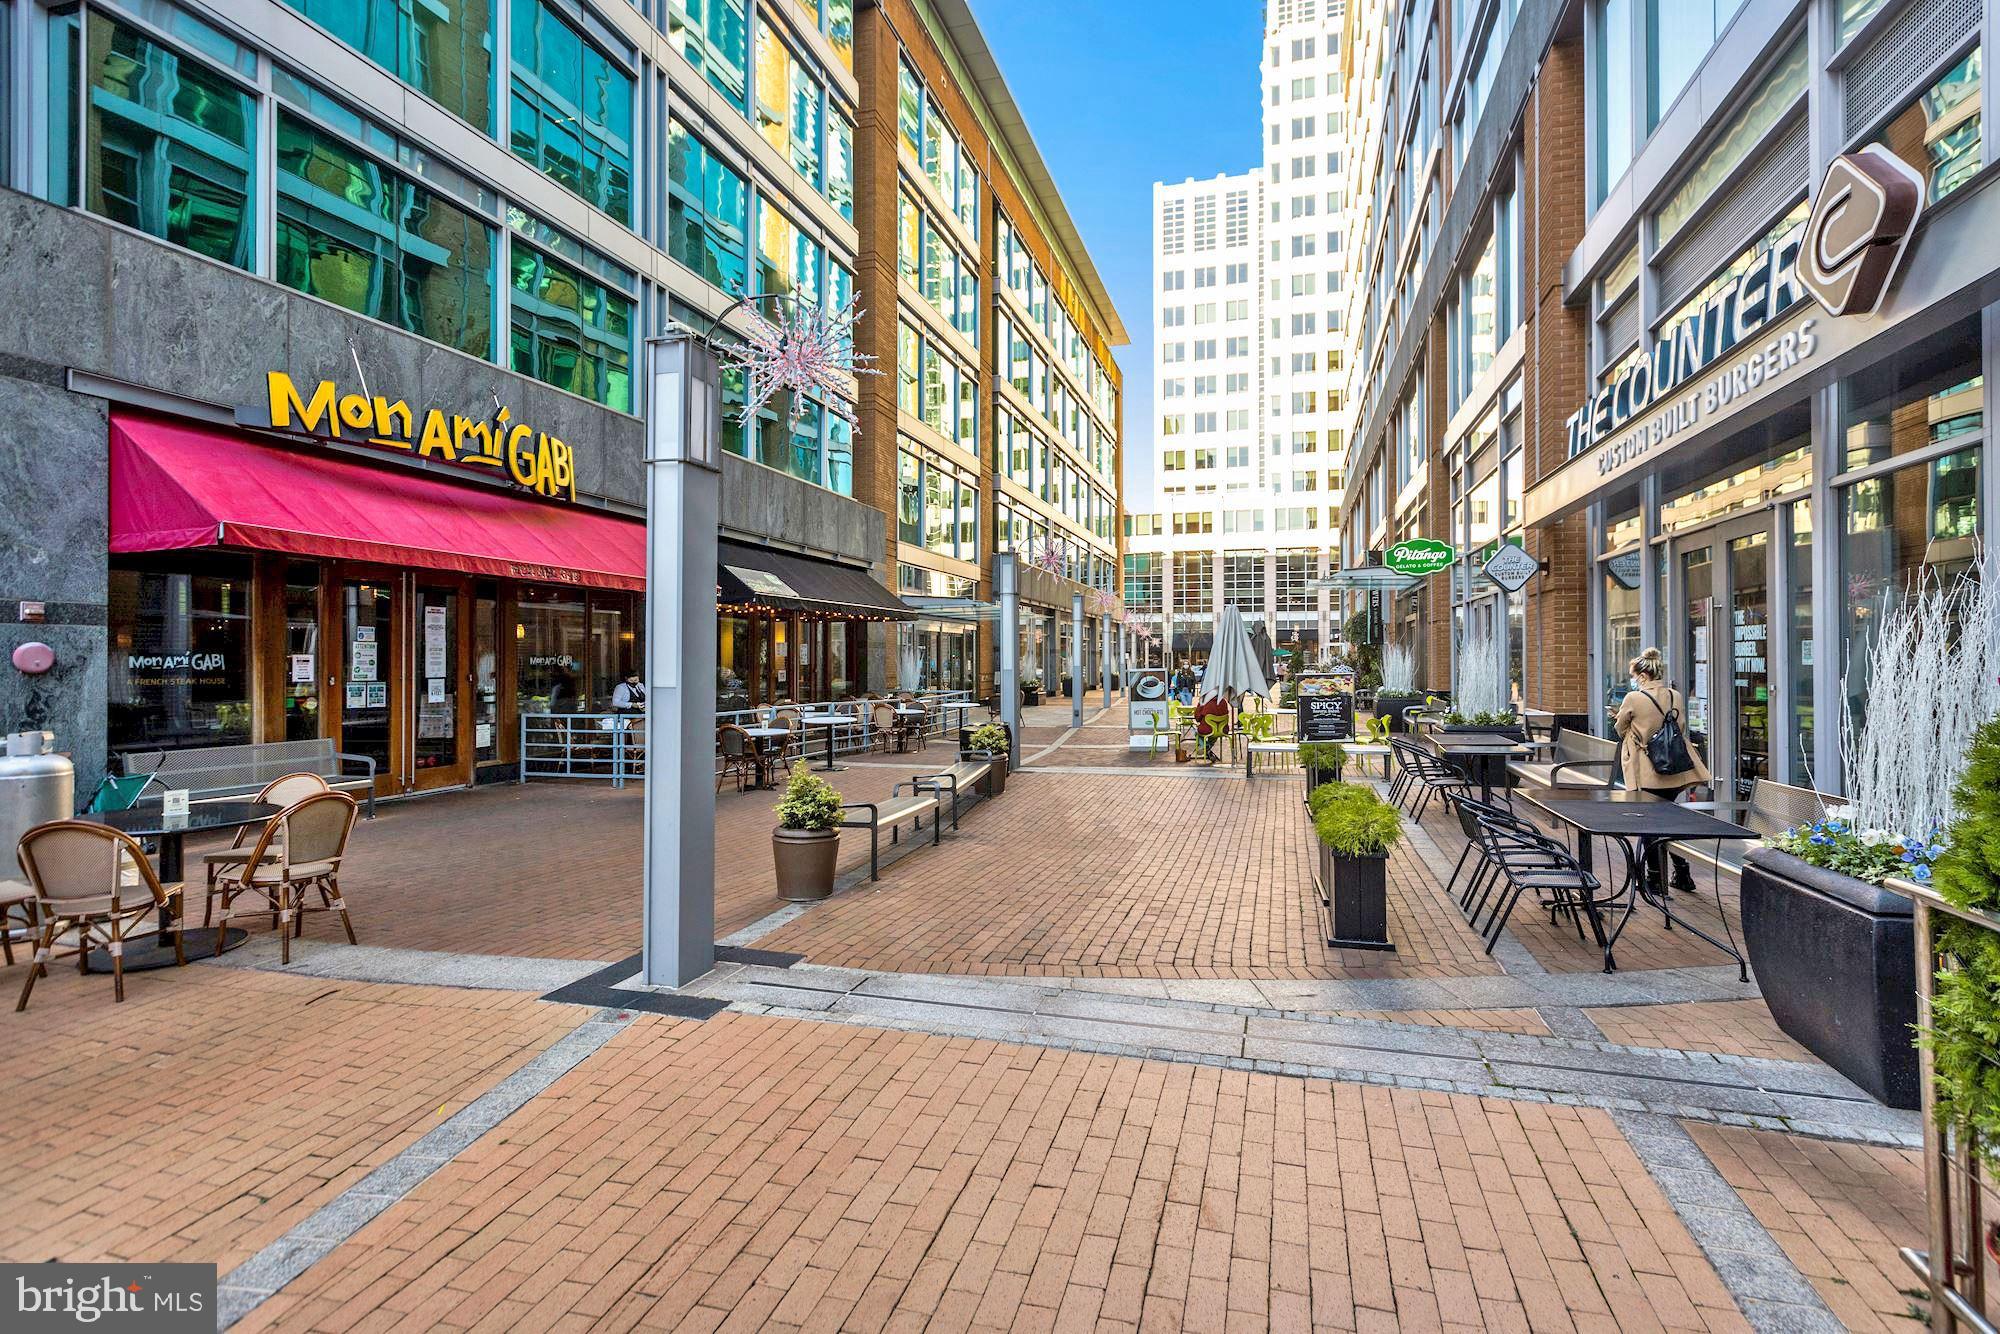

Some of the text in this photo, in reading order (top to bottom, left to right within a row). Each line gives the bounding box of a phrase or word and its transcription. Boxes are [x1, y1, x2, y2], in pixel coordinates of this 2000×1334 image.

[1565, 222, 1808, 461] THE COUNTER
[1598, 319, 1818, 477] CUSTOM BUILT BURGERS
[508, 424, 577, 503] GABI
[1394, 547, 1447, 562] Pitango
[1492, 563, 1535, 572] COUNTER
[1734, 610, 1745, 625] THE
[1735, 624, 1767, 640] IMPOSSIBLE
[192, 653, 225, 671] GABI
[200, 677, 226, 685] HOUSE
